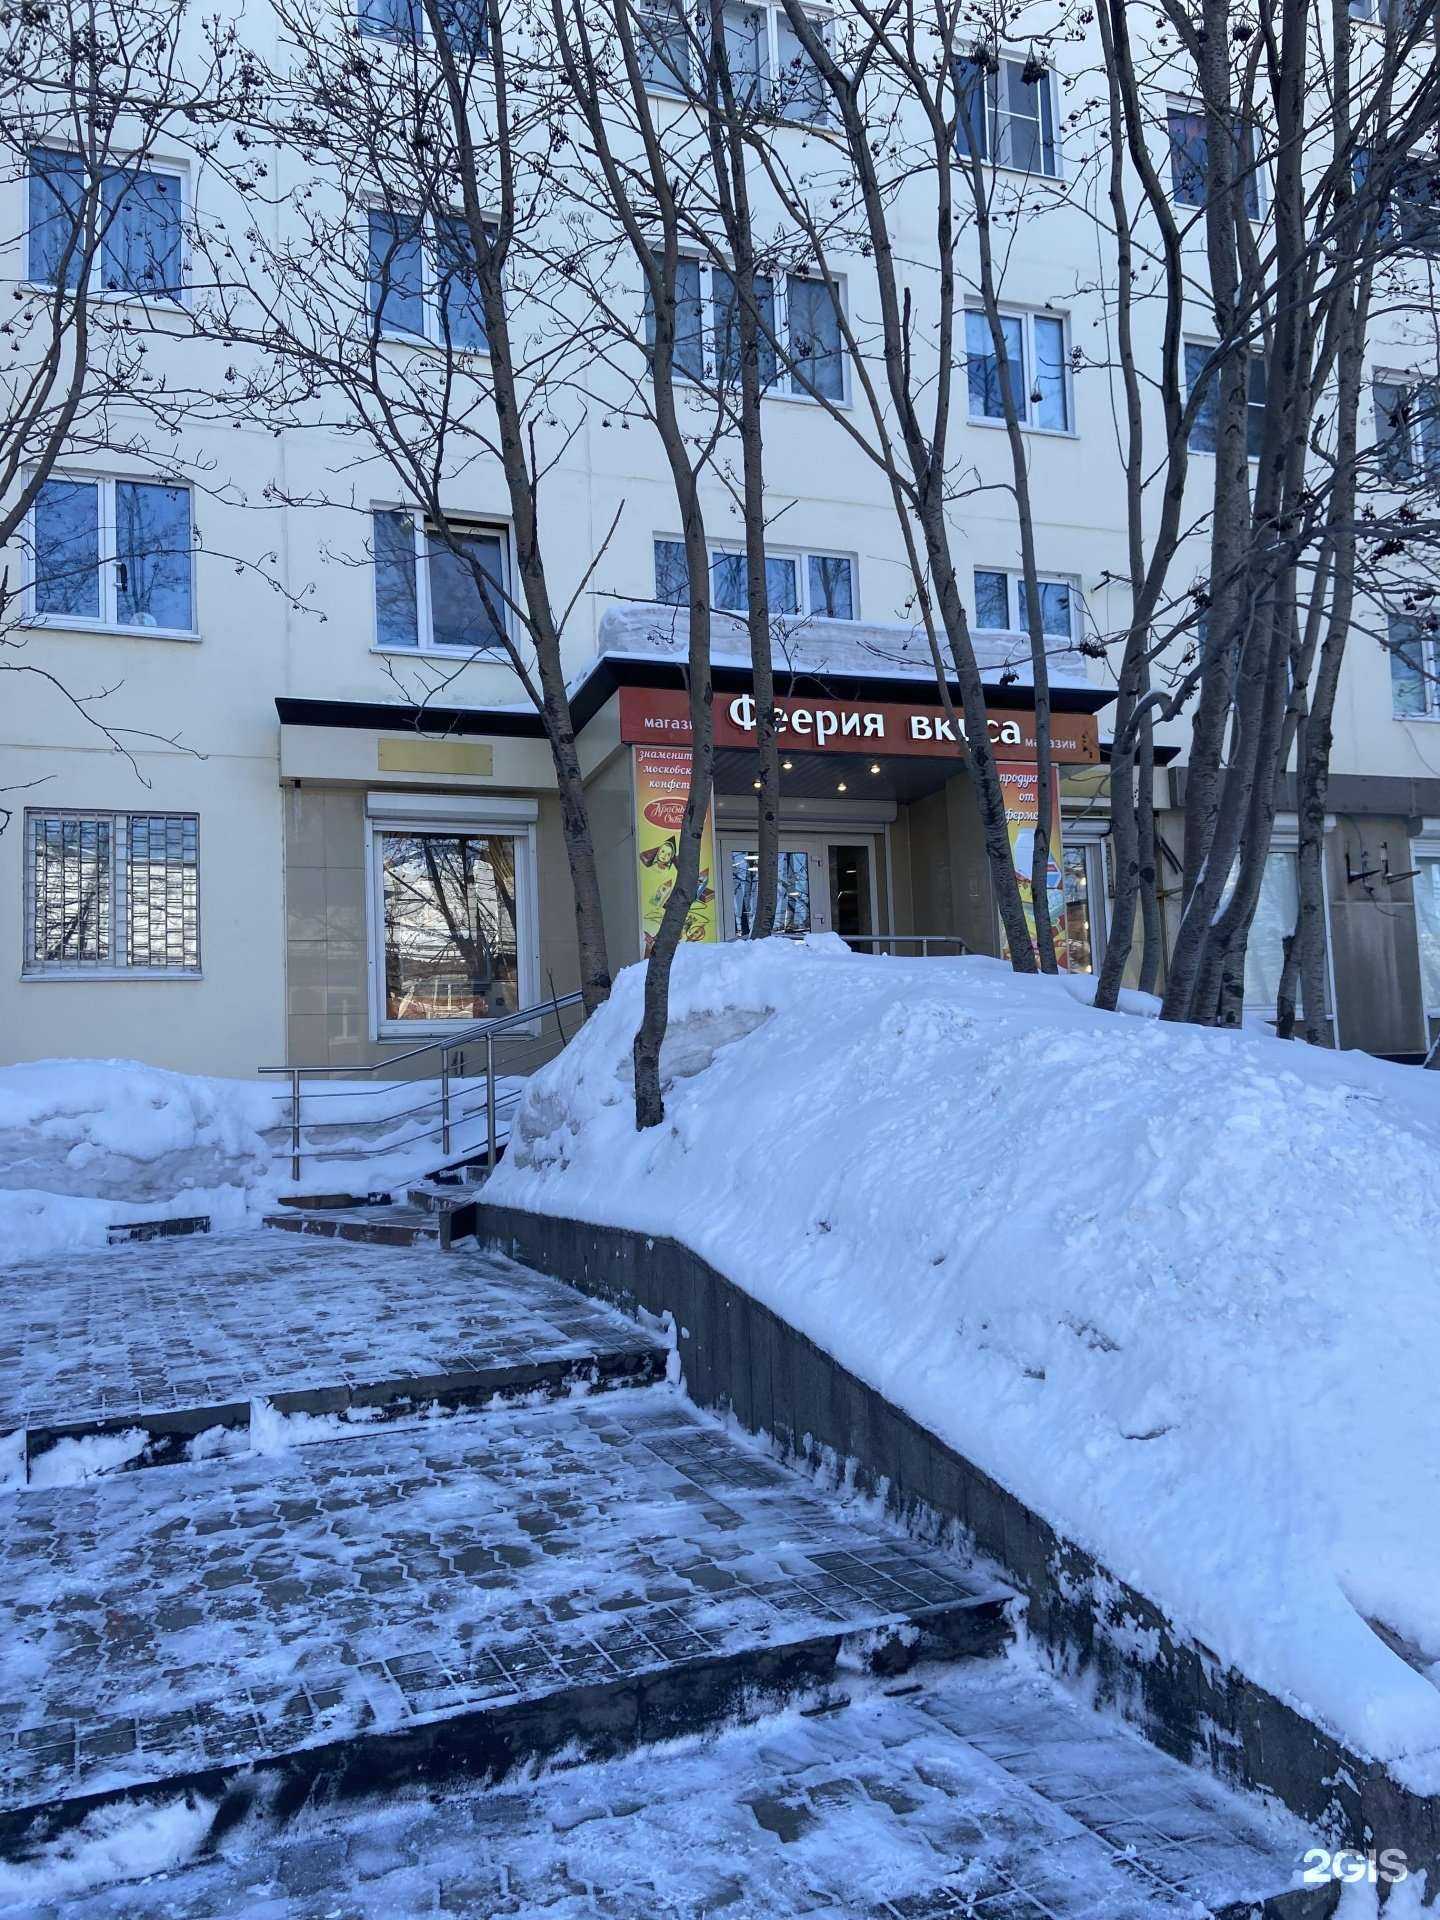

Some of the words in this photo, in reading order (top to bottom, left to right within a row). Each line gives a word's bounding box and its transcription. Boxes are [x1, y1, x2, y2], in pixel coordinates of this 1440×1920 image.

[644, 717, 692, 730] магаз
[910, 715, 1021, 752] вкса
[639, 750, 692, 761] знаменит
[643, 765, 692, 775] московск
[648, 779, 691, 793] конфет
[1000, 774, 1038, 788] продук
[1018, 792, 1036, 801] от
